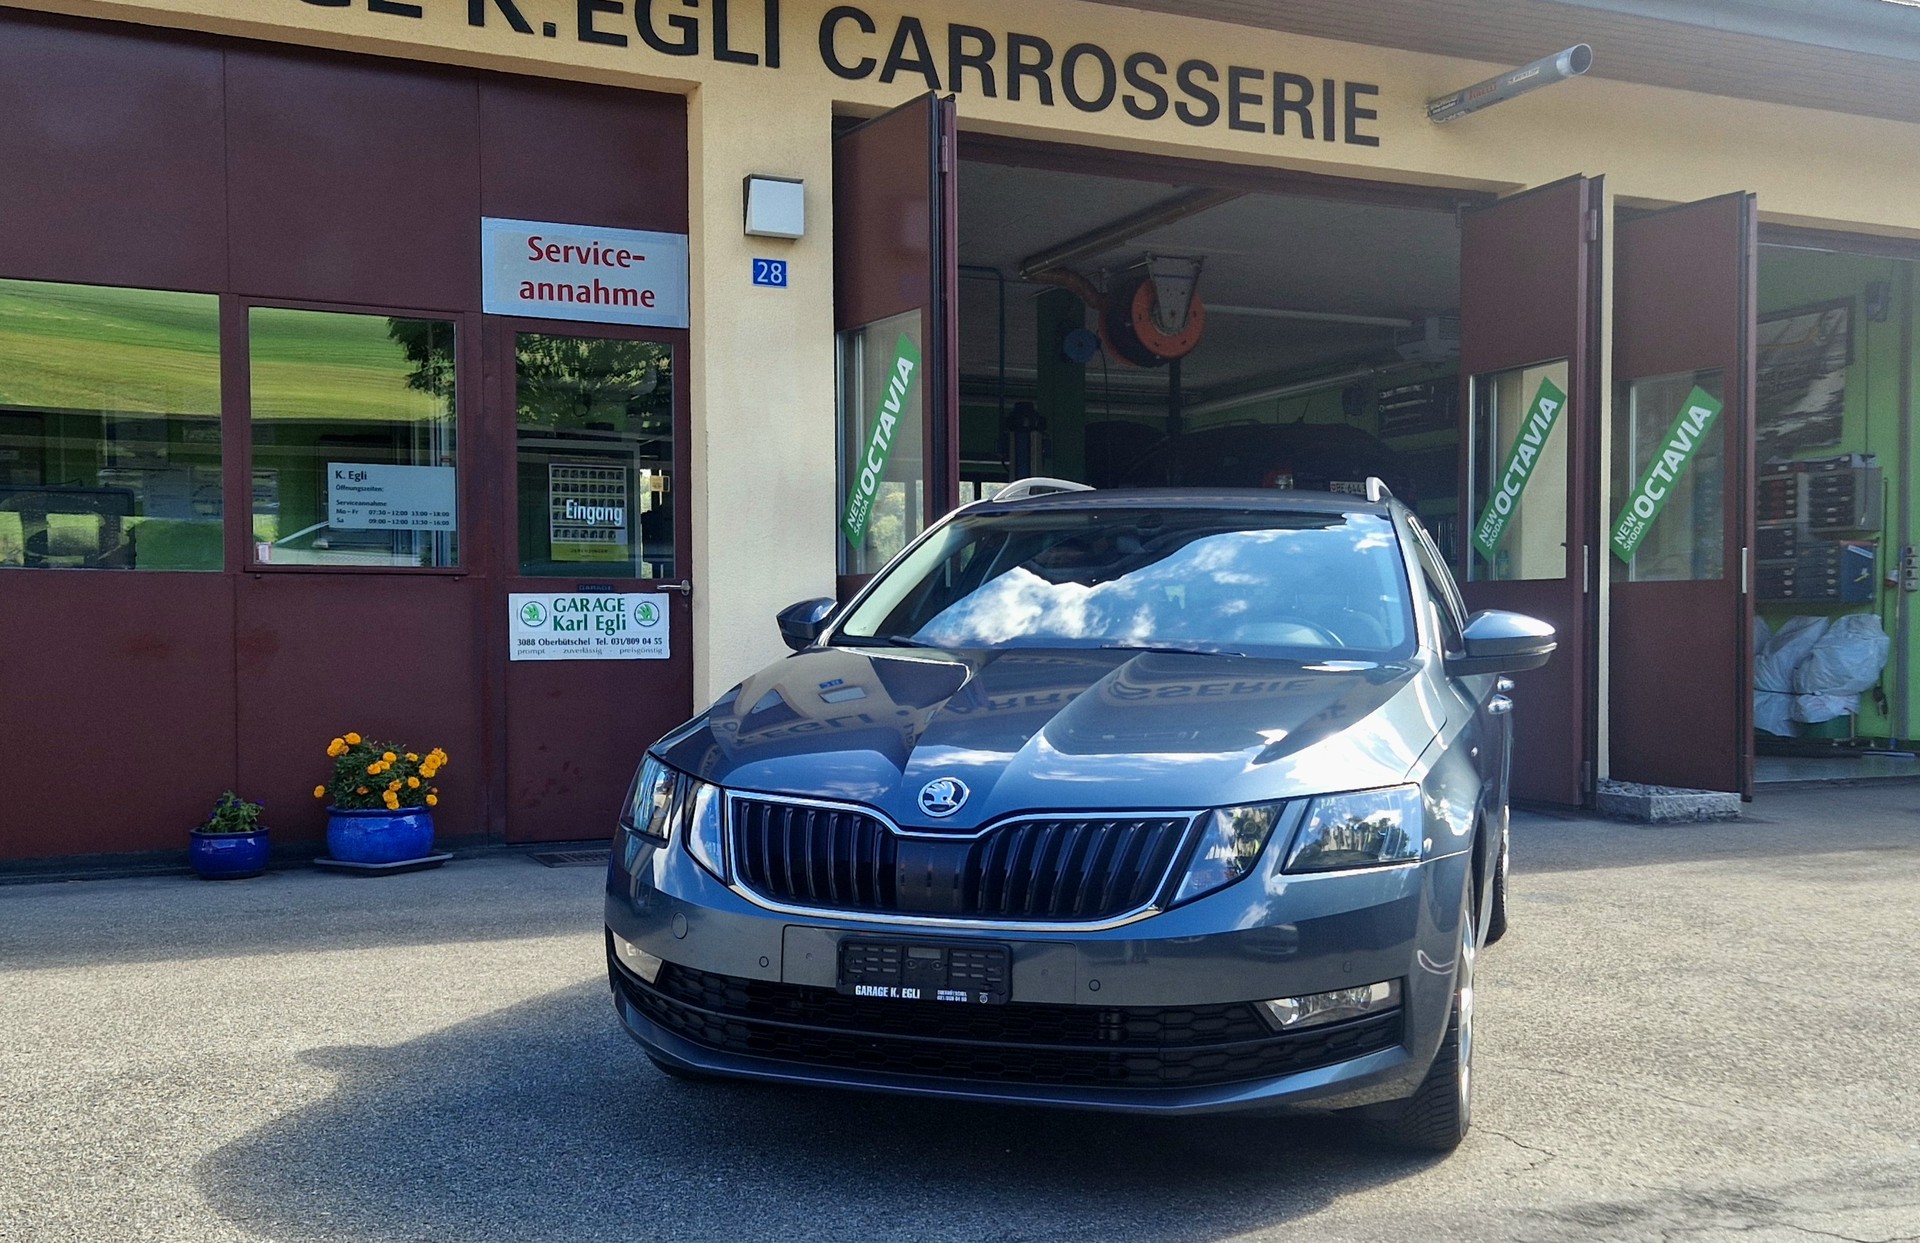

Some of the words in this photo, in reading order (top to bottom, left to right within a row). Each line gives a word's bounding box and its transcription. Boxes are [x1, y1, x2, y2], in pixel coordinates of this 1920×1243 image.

[577, 0, 780, 70] EGLI
[818, 5, 1380, 147] CARROSSERIE
[527, 235, 646, 268] Service-
[756, 261, 783, 284] 28
[519, 279, 656, 308] annahme
[860, 356, 914, 496] OCTAVIA
[1494, 397, 1559, 516] OCTAVIA
[1633, 405, 1713, 519] OCTAVIA
[335, 470, 346, 479] K.
[348, 470, 368, 482] Egli
[565, 499, 623, 527] Eingang
[847, 488, 864, 529] NEW
[1478, 509, 1498, 543] NEW
[1614, 511, 1638, 545] NEW
[553, 597, 626, 613] GARAGE
[553, 613, 588, 631] Karl
[595, 613, 627, 636] Egli
[517, 638, 536, 646] 3088
[538, 637, 590, 646] Oberbütschel
[595, 638, 608, 646] Tel.
[610, 637, 640, 645] 031/809
[517, 648, 546, 656] prompt
[563, 647, 603, 656] zuverlässig
[619, 647, 663, 655] preisgünstig
[855, 985, 888, 997] GARAGE
[890, 987, 900, 998] K.
[901, 988, 921, 999] EGLI
